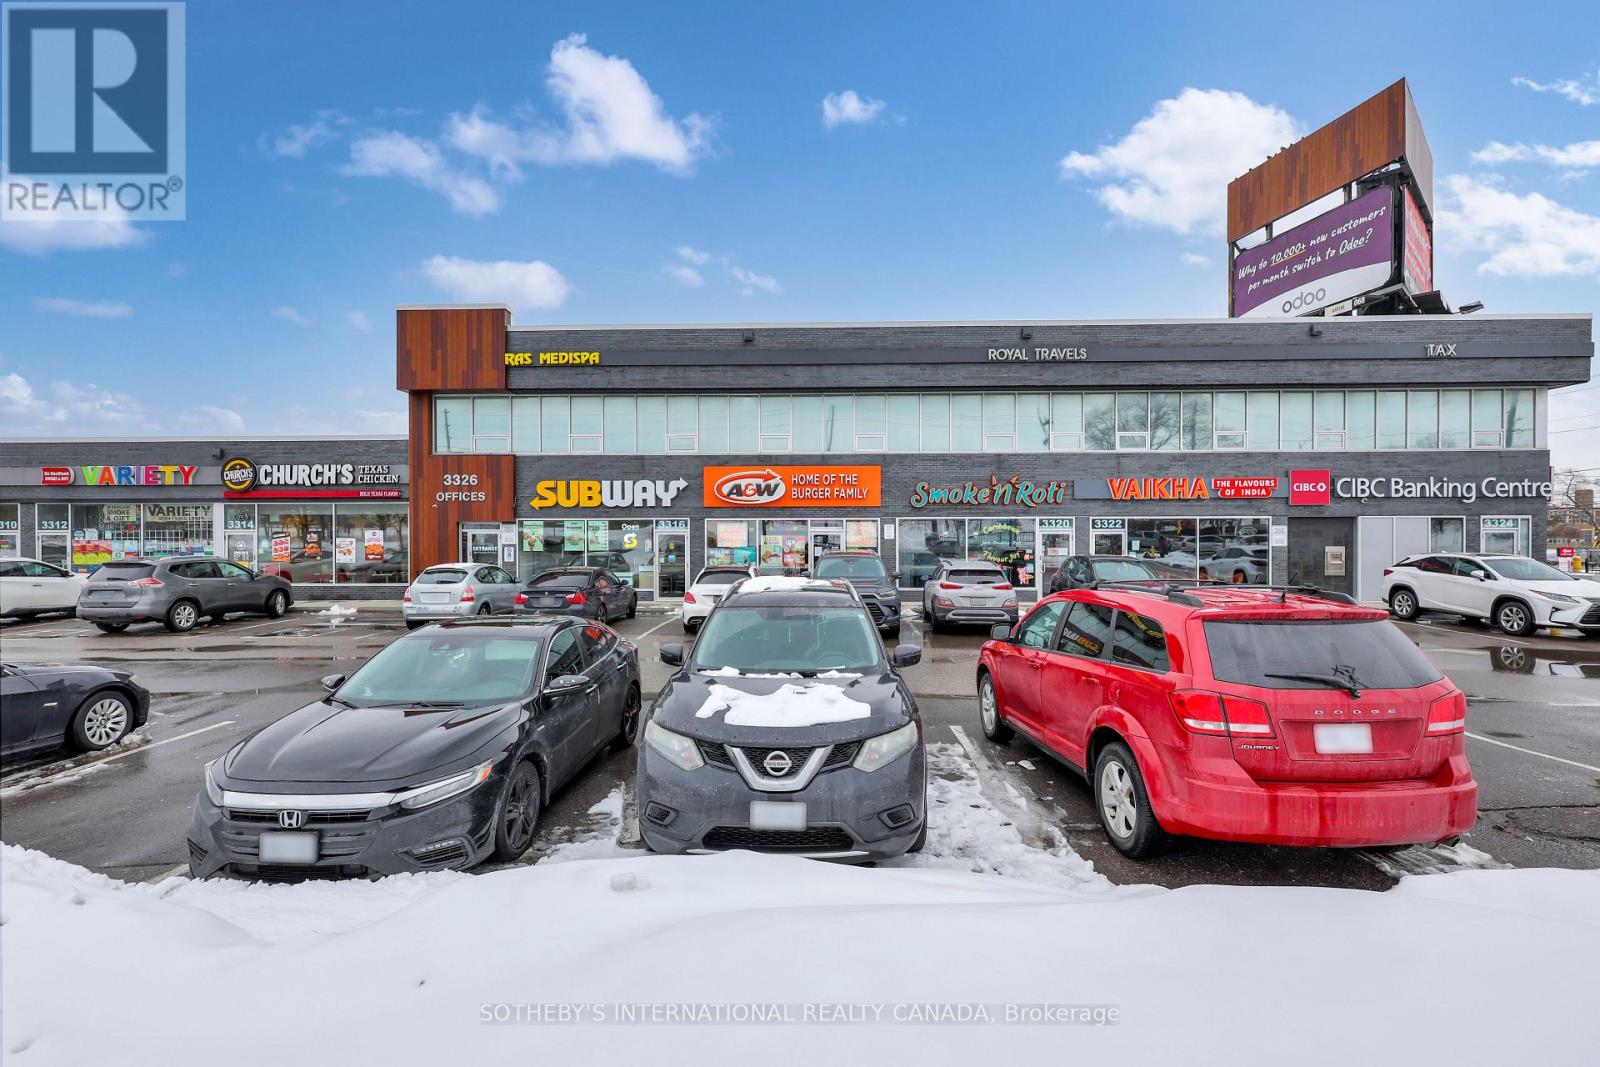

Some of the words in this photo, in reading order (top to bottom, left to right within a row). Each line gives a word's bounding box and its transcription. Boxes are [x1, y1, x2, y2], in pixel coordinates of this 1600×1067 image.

[1238, 264, 1257, 279] Why
[1259, 259, 1268, 269] do
[1271, 243, 1306, 263] 10,000+
[1310, 232, 1329, 246] new
[1331, 206, 1386, 237] customers
[1248, 281, 1260, 295] per
[1263, 266, 1289, 285] month
[1292, 251, 1322, 274] switch
[1326, 247, 1336, 260] to
[1340, 228, 1373, 254] Odoo?
[1282, 288, 1326, 313] odoo
[988, 348, 1028, 360] ROYAL
[1035, 348, 1087, 360] TRAVELS
[1427, 343, 1457, 357] TAX
[504, 352, 533, 366] RAS
[540, 351, 600, 365] MEDISPA
[223, 468, 253, 481] CHURCH'S
[359, 465, 389, 473] TEXAS
[81, 465, 198, 485] VARIETY
[260, 464, 354, 487] CHURCH'S
[358, 475, 399, 483] CHICKEN
[443, 474, 478, 485] 3326
[791, 474, 820, 484] HOME
[822, 474, 836, 484] OF
[839, 474, 858, 484] THE
[726, 482, 780, 497] A&W
[1107, 477, 1210, 500] VAIKHA
[1293, 482, 1316, 492] CIBC
[1336, 477, 1386, 498] CIBC
[1391, 476, 1477, 503] Banking
[1481, 477, 1552, 498] Centre
[436, 492, 486, 502] OFFICES
[528, 477, 689, 511] SUBWAY
[791, 488, 830, 499] BURGER
[834, 488, 868, 499] FAMILY
[910, 481, 990, 507] Smoke
[1015, 481, 1067, 507] Roti
[147, 505, 211, 516] VARIETY
[41, 521, 68, 529] 3312
[228, 520, 254, 529] 3314
[621, 523, 640, 531] Open
[658, 520, 685, 529] 3316
[1042, 519, 1069, 528] 3320
[1094, 519, 1122, 528] 3322
[1485, 519, 1513, 527] 3324
